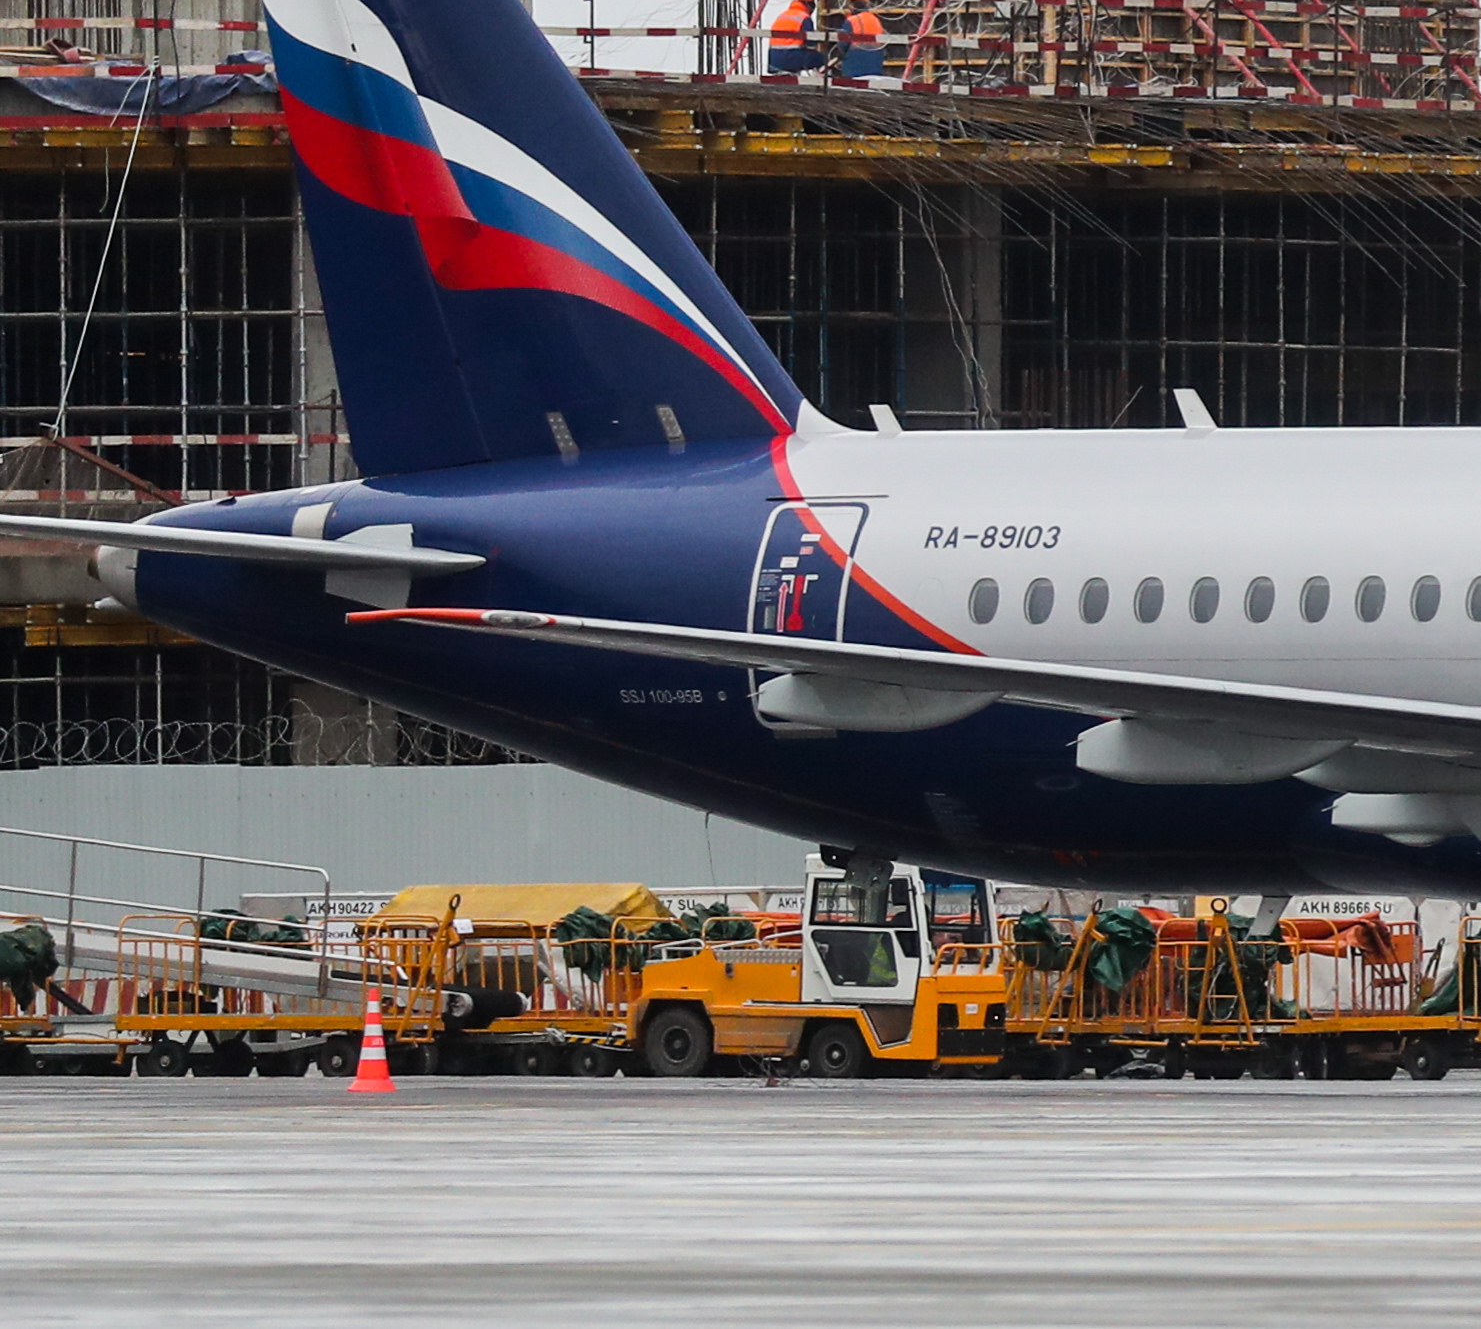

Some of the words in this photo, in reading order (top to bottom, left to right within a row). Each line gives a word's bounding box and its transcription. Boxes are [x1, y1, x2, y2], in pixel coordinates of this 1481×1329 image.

[923, 525, 1062, 550] RA-89103
[619, 689, 646, 705] SSJ
[650, 689, 704, 705] 100-95B
[338, 902, 375, 915] 90422
[678, 899, 696, 911] SU
[778, 897, 798, 909] AKH
[1300, 901, 1330, 914] AKH
[1333, 901, 1371, 914] 89666
[1374, 901, 1393, 914] SU
